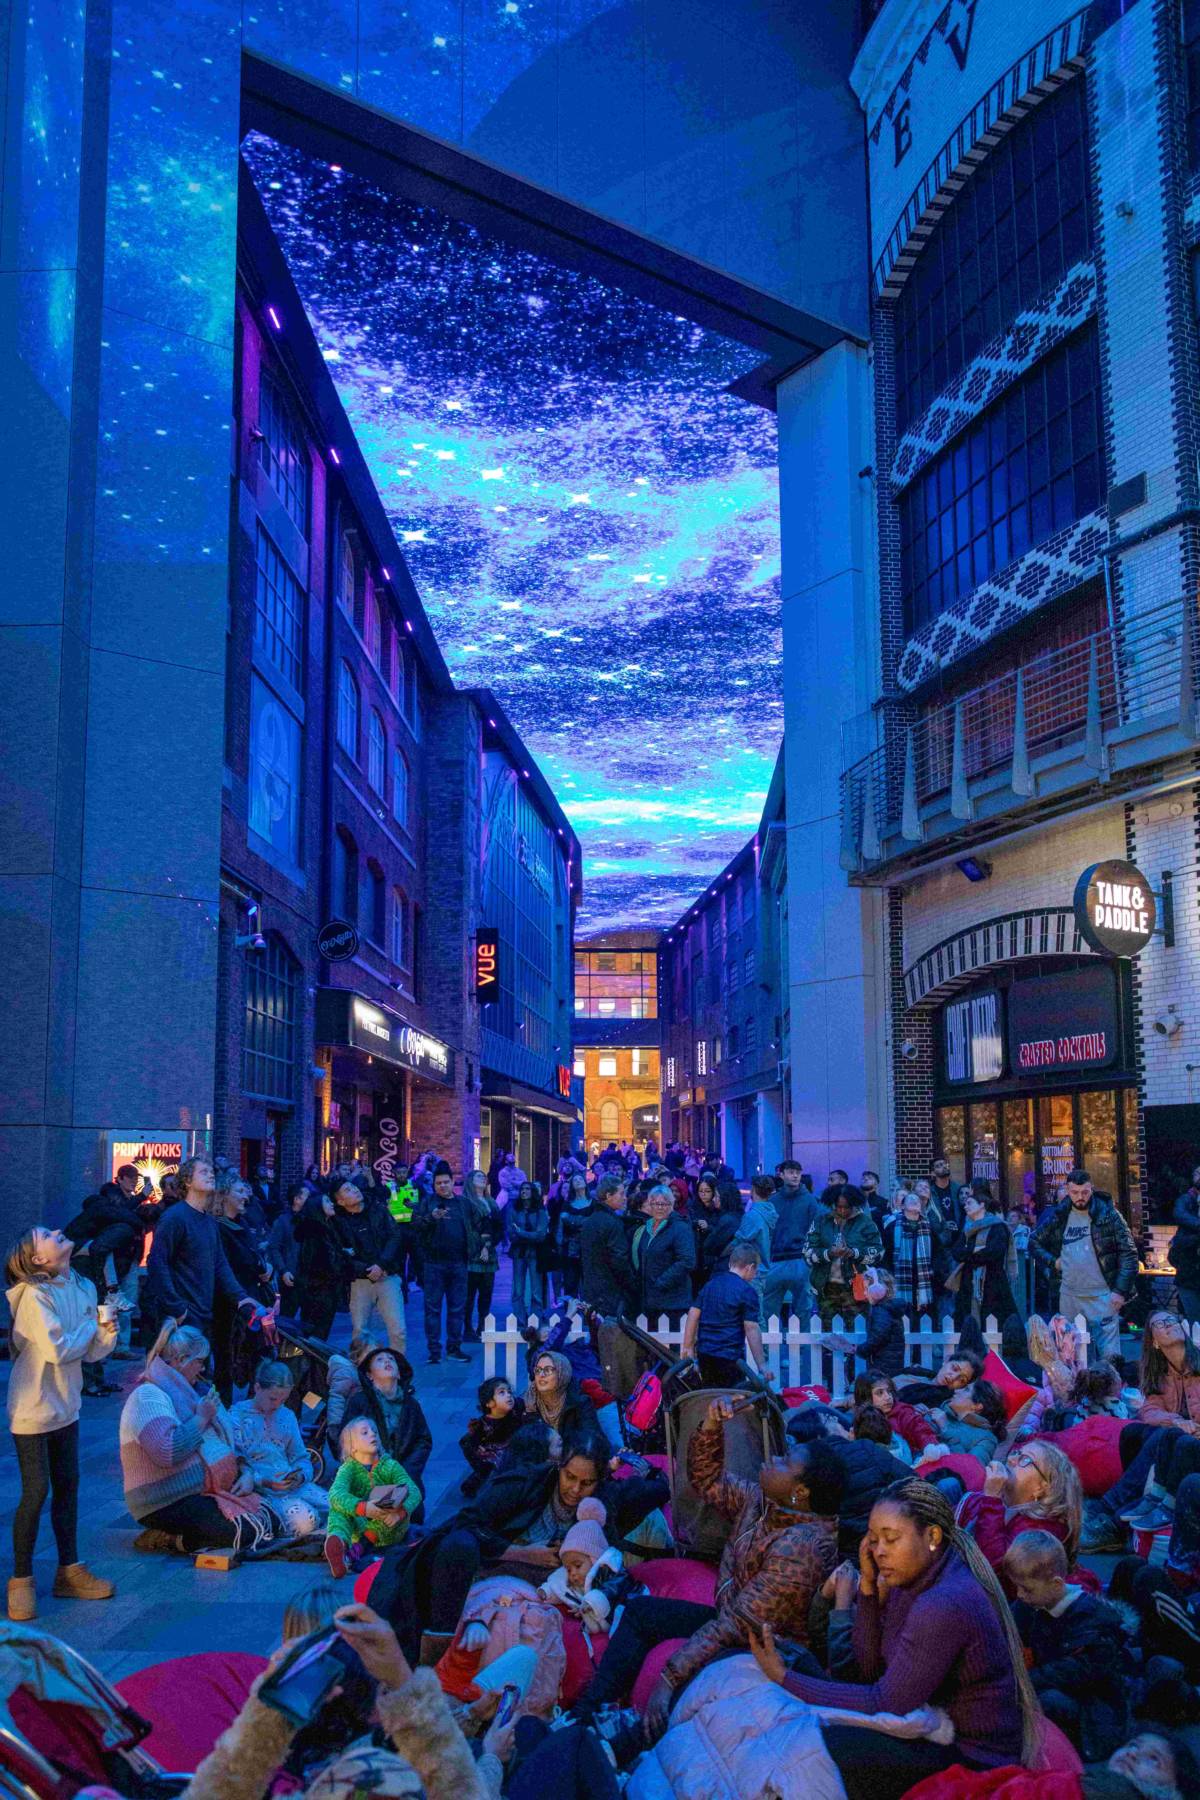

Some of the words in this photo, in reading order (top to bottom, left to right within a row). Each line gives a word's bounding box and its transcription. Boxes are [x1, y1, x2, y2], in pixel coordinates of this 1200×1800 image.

[1095, 905, 1149, 934] PADDLE
[1019, 1039, 1056, 1068] CRAFTED
[1058, 1032, 1106, 1063] COCKTAILS
[113, 1142, 181, 1157] PRINTWORKS
[1066, 1226, 1090, 1238] NIKE
